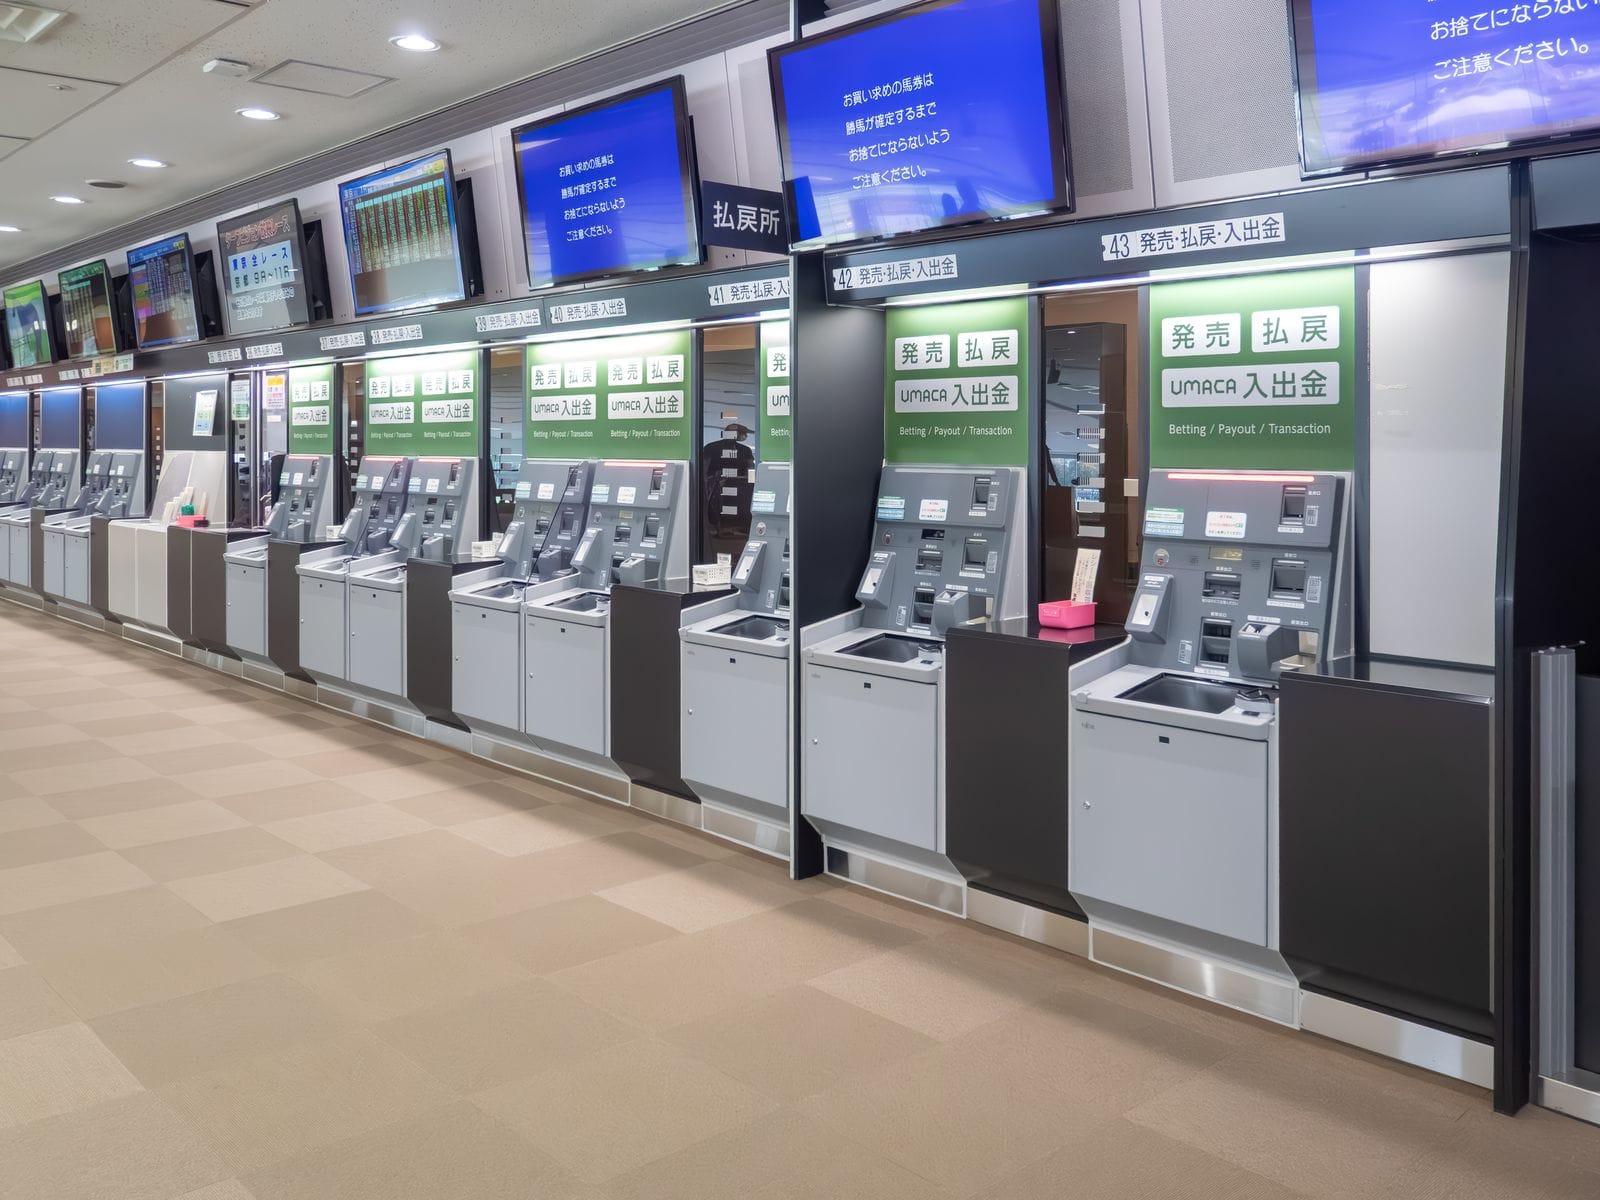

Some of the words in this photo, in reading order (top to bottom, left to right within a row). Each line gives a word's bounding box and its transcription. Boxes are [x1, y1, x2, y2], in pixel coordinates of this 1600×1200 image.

[1433, 37, 1589, 80] ご注意ください。
[843, 72, 935, 108] お買い求めの馬券は
[845, 101, 937, 136] 勝馬が確定するまで
[848, 129, 951, 162] お捨てにならないよう
[558, 154, 615, 178] お買い求めの馬券は
[851, 164, 928, 190] ご注意ください。
[560, 177, 618, 200] 勝馬が確定するまで
[563, 197, 627, 221] お捨てにならないよう
[713, 200, 780, 236] 払戻所
[566, 224, 613, 242] ご注意ください。
[1108, 233, 1130, 259] 43
[838, 268, 853, 289] 42
[713, 287, 724, 304] 41
[554, 306, 564, 322] 40
[1172, 322, 1229, 349] 発売
[1263, 316, 1327, 345] 払戻
[902, 342, 942, 364] 発売
[966, 337, 1009, 361] 払戻
[613, 365, 637, 380] 発売
[652, 360, 679, 379] 払戻
[773, 353, 786, 371] 発
[535, 370, 556, 385] 発売
[568, 366, 592, 384] 払戻
[1171, 379, 1236, 395] UMACA
[1243, 370, 1327, 399] 入出金
[612, 401, 640, 411] UMACA
[643, 395, 678, 413] 入出金
[901, 389, 946, 402] UMACA
[952, 382, 1009, 405] 入出金
[535, 404, 559, 413] UMACA
[562, 399, 591, 415] 入出金
[611, 429, 628, 439] Betting
[633, 429, 649, 439] Payout
[654, 429, 681, 437] Transaction
[771, 427, 790, 438] Bettin
[900, 426, 927, 438] Betting
[935, 426, 961, 438] Payout
[970, 425, 1013, 436] Transaction
[1169, 423, 1207, 437] Betting
[1219, 423, 1256, 437] Payout
[1269, 423, 1331, 434] Transaction
